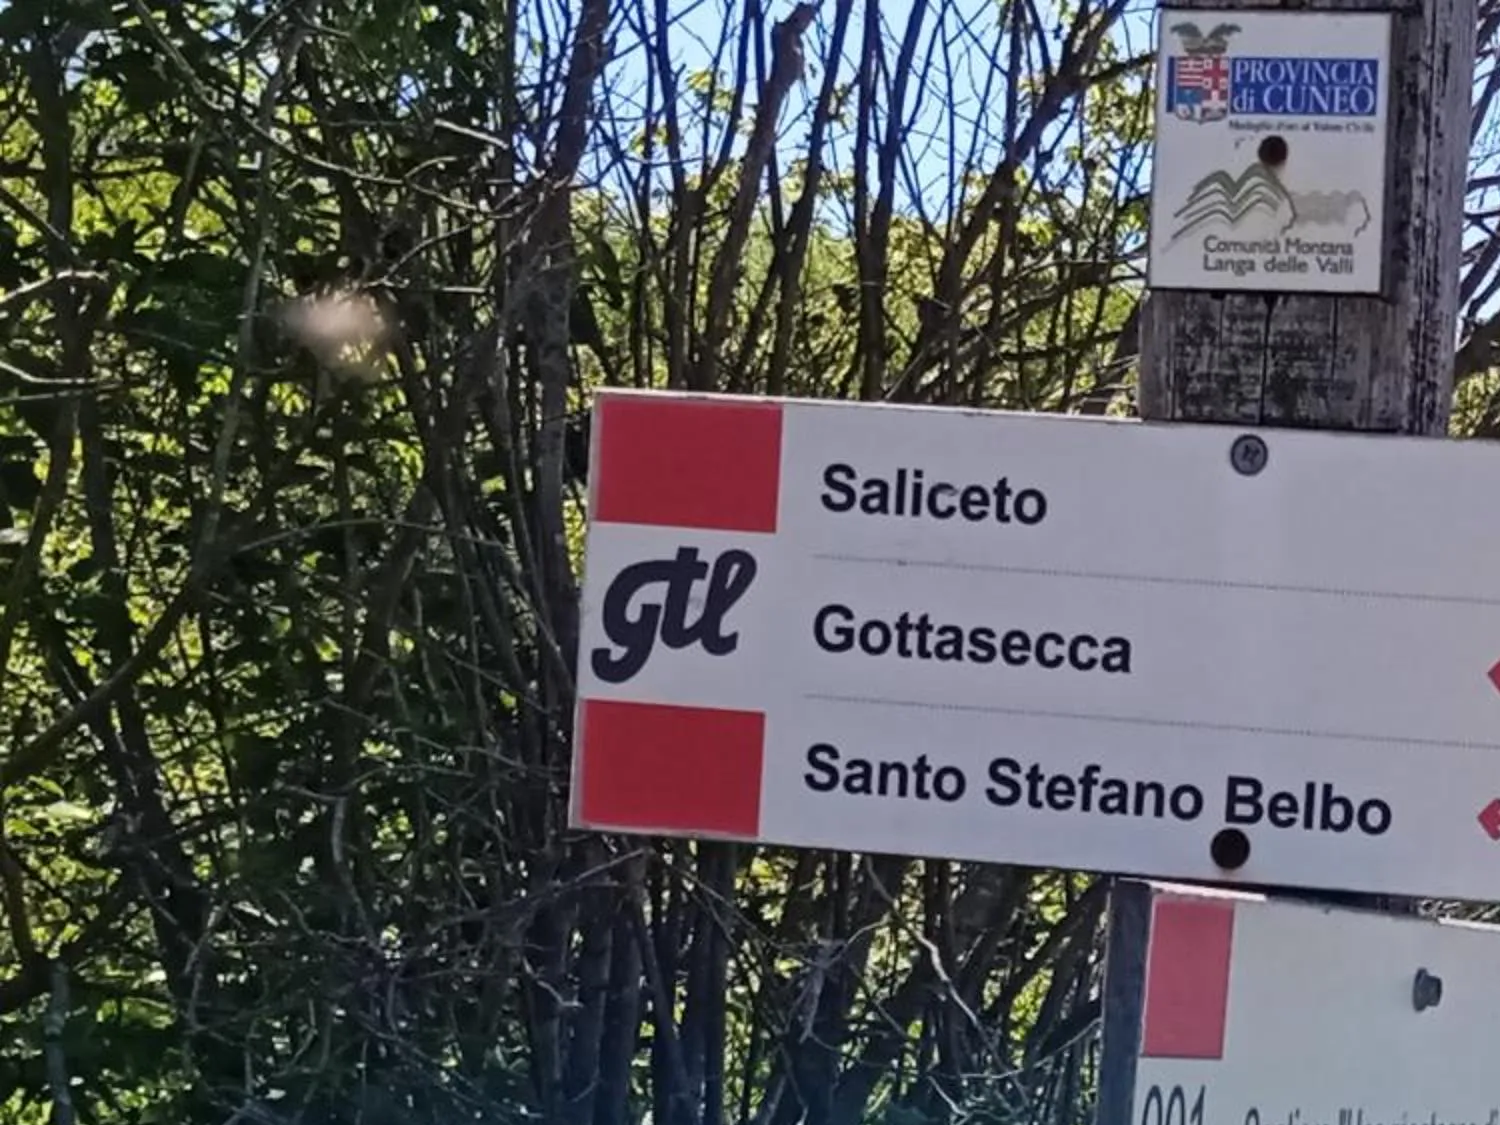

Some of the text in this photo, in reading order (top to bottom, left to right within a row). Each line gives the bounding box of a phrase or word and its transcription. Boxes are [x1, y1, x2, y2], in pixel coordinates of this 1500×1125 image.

[1234, 60, 1374, 85] PROVINCIA
[1233, 84, 1375, 113] di CUNEO
[1203, 254, 1354, 276] Langa delle Valli
[1285, 238, 1354, 256] Montana
[820, 464, 1048, 526] Saliceto
[590, 546, 758, 683] gtl
[812, 604, 1132, 674] Gottasecca
[804, 743, 1392, 836] Santo Stefano Belbo
